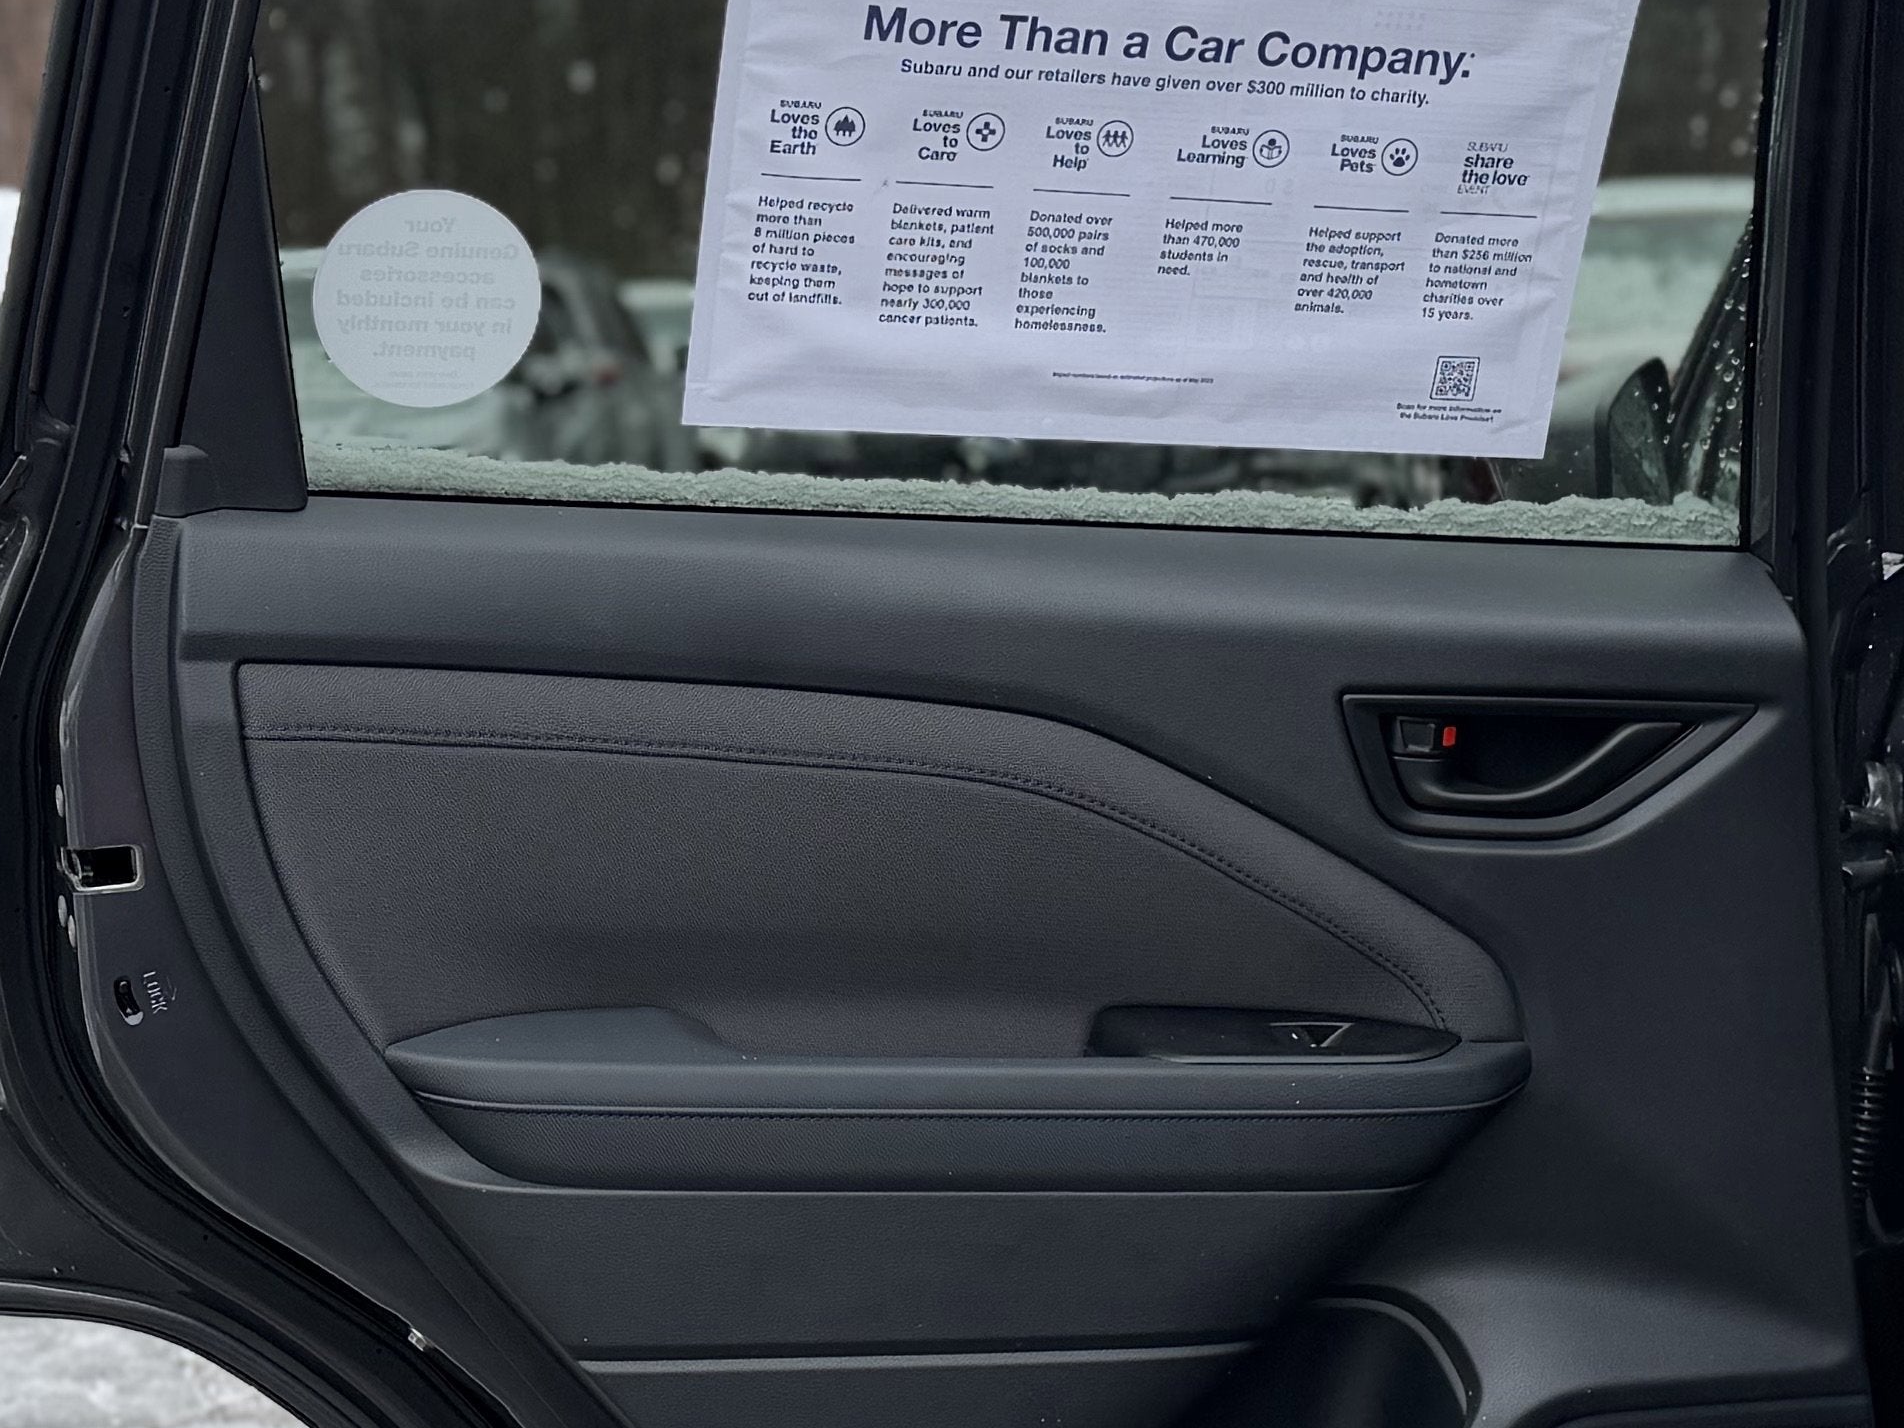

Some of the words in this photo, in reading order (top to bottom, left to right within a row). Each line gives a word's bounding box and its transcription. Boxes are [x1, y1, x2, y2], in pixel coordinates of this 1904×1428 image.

[863, 4, 982, 49] More
[998, 14, 1109, 57] Than
[1122, 28, 1148, 59] a
[1164, 25, 1245, 64] Car
[1257, 32, 1471, 86] Company.
[900, 59, 962, 77] Subaru
[967, 64, 1000, 80] and
[1004, 68, 1032, 82] our
[1037, 69, 1106, 86] retailers
[1111, 72, 1151, 88] have
[1155, 75, 1202, 93] given
[1206, 81, 1243, 94] over
[1247, 80, 1286, 98] $300
[1290, 83, 1345, 98] million
[1349, 86, 1367, 100] to
[1371, 86, 1429, 105] charity.
[770, 109, 820, 125] Loves
[792, 126, 818, 140] the
[912, 118, 961, 134] Loves
[1046, 126, 1092, 141] Loves
[770, 140, 817, 155] Earth
[943, 136, 958, 148] to
[1075, 143, 1090, 155] to
[1202, 135, 1247, 151] Loves
[918, 147, 957, 162] Care
[1331, 143, 1376, 158] Loves
[1053, 155, 1087, 171] Help
[1177, 149, 1245, 168] Learning
[1463, 153, 1514, 169] share
[1340, 159, 1373, 173] Pets
[1462, 170, 1489, 184] the
[1492, 172, 1527, 186] love
[758, 196, 804, 211] Helped
[807, 201, 853, 213] recycle
[893, 203, 952, 218] Delivered
[956, 208, 991, 219] warm
[756, 213, 790, 224] more
[793, 214, 822, 226] than
[1030, 210, 1083, 224] Donated
[1086, 215, 1112, 226] over
[891, 219, 947, 234] blankets,
[951, 224, 994, 237] patient
[1165, 219, 1208, 232] Helped
[1211, 222, 1243, 233] more
[766, 229, 809, 241] million
[813, 232, 855, 244] pieces
[1027, 226, 1074, 240] 500,000
[1077, 229, 1109, 242] pairs
[1163, 234, 1190, 246] than
[1309, 227, 1351, 240] Helped
[1355, 231, 1401, 243] support
[1434, 233, 1485, 246] Donated
[1488, 236, 1518, 247] more
[752, 243, 766, 253] of
[769, 244, 798, 255] hard
[801, 247, 814, 256] to
[888, 237, 916, 247] care
[948, 239, 972, 249] and
[1025, 242, 1039, 253] of
[1042, 244, 1077, 254] socks
[1081, 246, 1105, 256] and
[1306, 242, 1325, 253] the
[1328, 245, 1384, 257] adoption,
[886, 252, 965, 266] encouraging
[1160, 250, 1214, 262] students
[1217, 252, 1228, 262] in
[1432, 248, 1458, 259] than
[1492, 252, 1532, 263] million
[751, 260, 796, 274] recycle
[800, 264, 842, 275] waste,
[1023, 258, 1070, 271] 100,000
[1157, 265, 1191, 276] need.
[1303, 258, 1347, 271] rescue,
[1351, 261, 1405, 273] transport
[1429, 263, 1441, 273] to
[1444, 264, 1491, 275] national
[1494, 266, 1517, 276] and
[885, 267, 948, 281] messages
[952, 269, 964, 279] of
[1020, 273, 1073, 285] blankets
[1076, 276, 1089, 285] to
[1300, 273, 1323, 283] and
[1326, 274, 1363, 286] health
[1367, 275, 1379, 285] of
[749, 275, 799, 289] keeping
[804, 278, 835, 289] them
[1426, 277, 1487, 290] hometown
[882, 282, 914, 296] hope
[918, 284, 930, 293] to
[934, 285, 983, 297] support
[1018, 288, 1053, 299] those
[1298, 288, 1324, 297] over
[748, 291, 769, 301] out
[773, 291, 785, 302] of
[789, 293, 842, 305] landfills.
[880, 297, 918, 311] nearly
[1423, 293, 1474, 305] charities
[1477, 296, 1504, 306] over
[1016, 304, 1096, 319] experiencing
[1295, 301, 1344, 314] animals.
[879, 313, 921, 325] cancer
[924, 315, 978, 328] patients.
[1422, 308, 1435, 318] 15
[1438, 310, 1473, 322] years.
[1015, 319, 1106, 333] homelessness.
[143, 971, 168, 1014] LOCK
